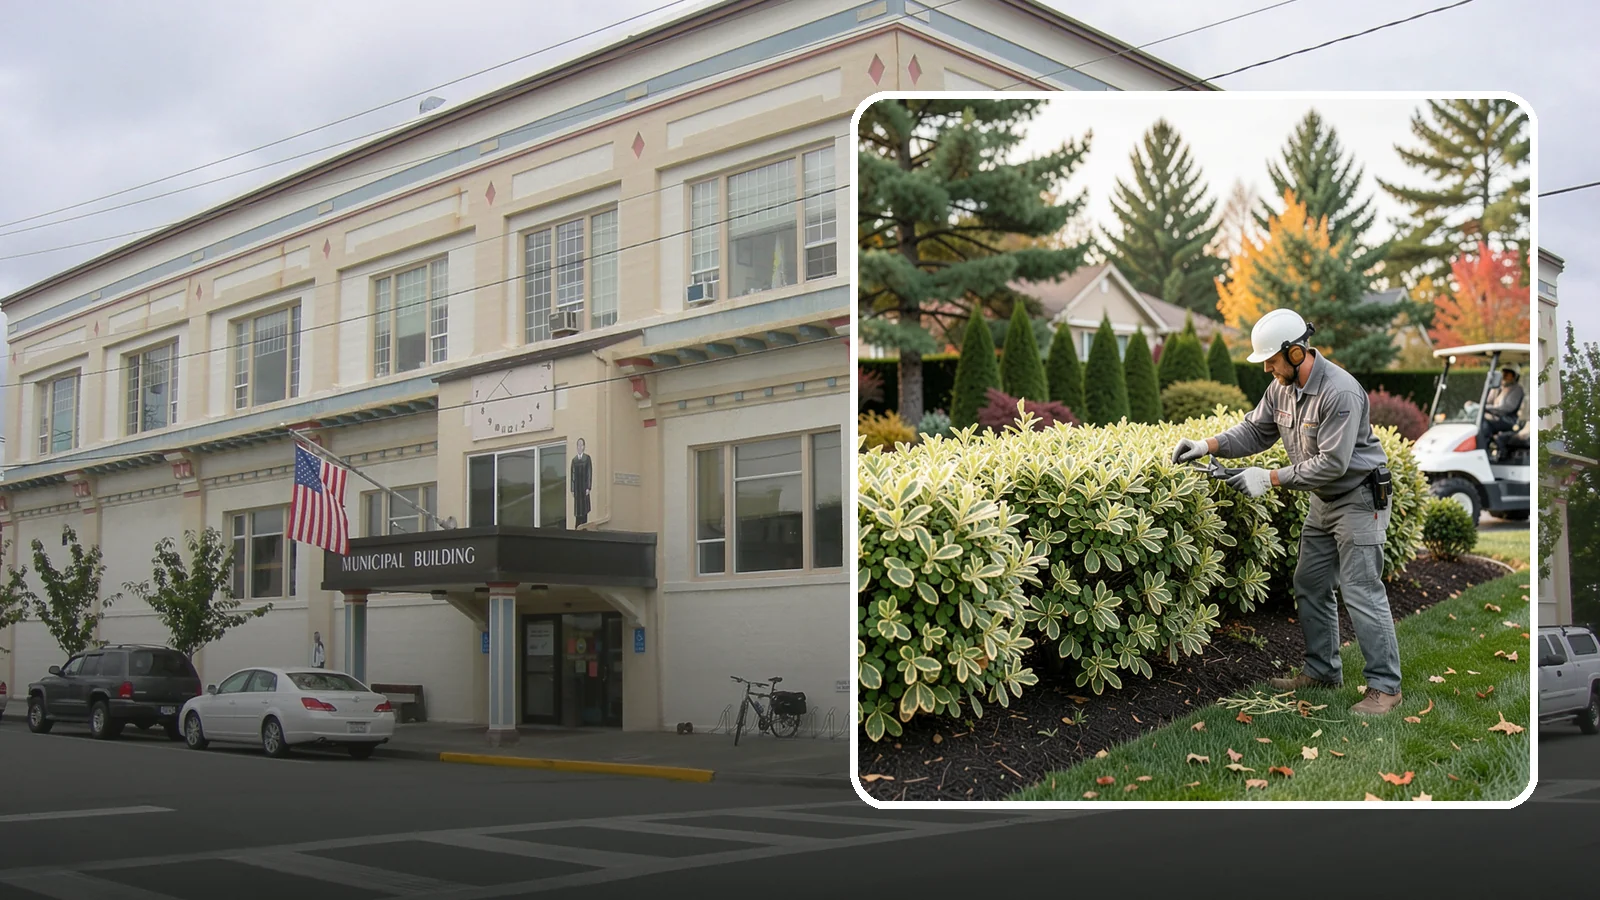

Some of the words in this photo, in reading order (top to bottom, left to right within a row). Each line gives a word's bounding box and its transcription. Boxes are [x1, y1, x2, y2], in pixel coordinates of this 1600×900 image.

[481, 407, 485, 415] 8
[488, 418, 492, 426] 9
[494, 424, 500, 432] 10
[507, 425, 513, 433] 12
[529, 414, 533, 422] 3
[536, 402, 540, 410] 4
[342, 552, 405, 572] MUNICIPAL
[414, 546, 475, 567] BUILDING
